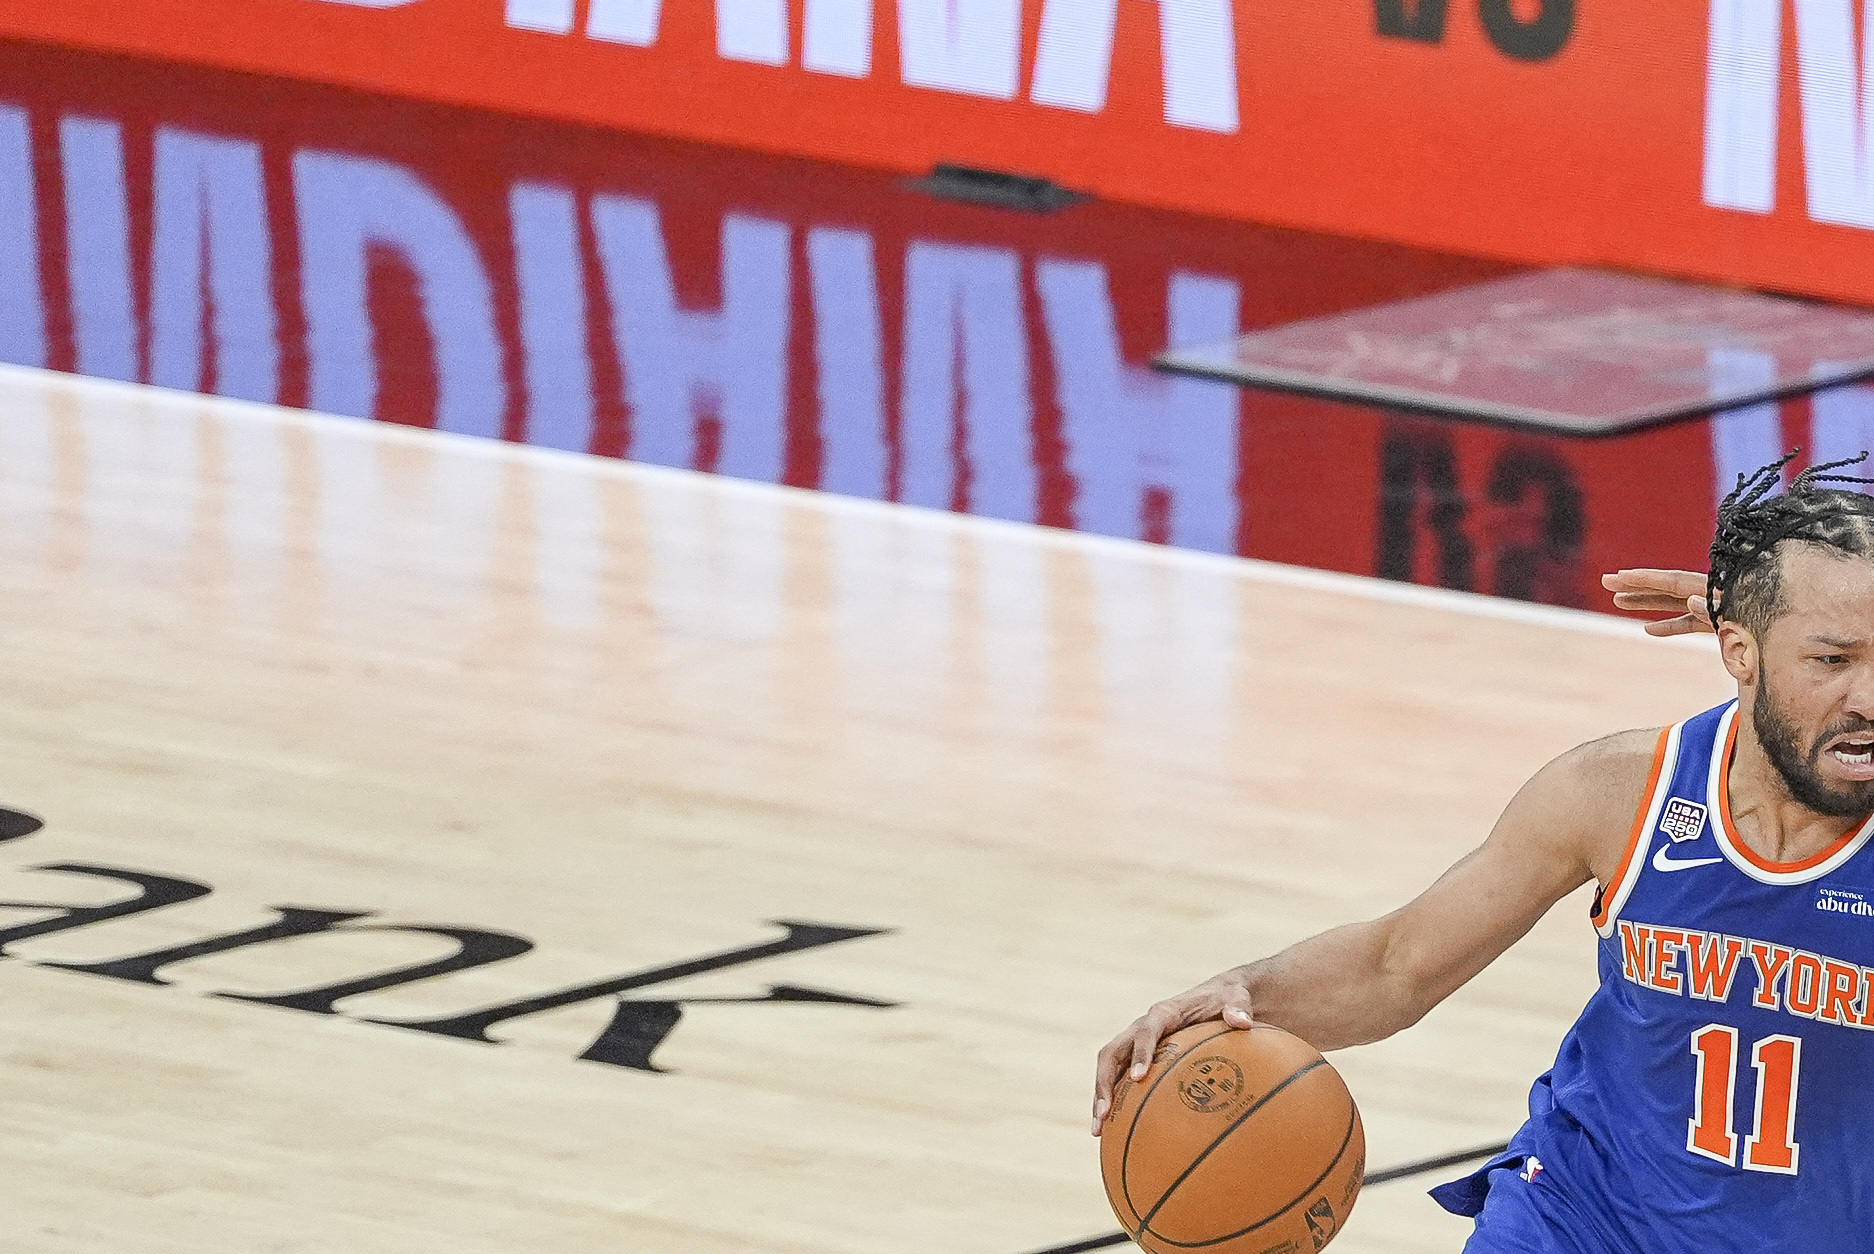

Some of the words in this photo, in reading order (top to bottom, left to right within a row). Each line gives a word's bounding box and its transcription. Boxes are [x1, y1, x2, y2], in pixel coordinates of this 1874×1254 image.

[1671, 802, 1701, 820] USA
[1664, 818, 1698, 837] 250
[1819, 888, 1864, 901] experience
[1816, 896, 1849, 913] abu
[1617, 920, 1746, 1004] NEW
[1686, 1023, 1802, 1176] 11
